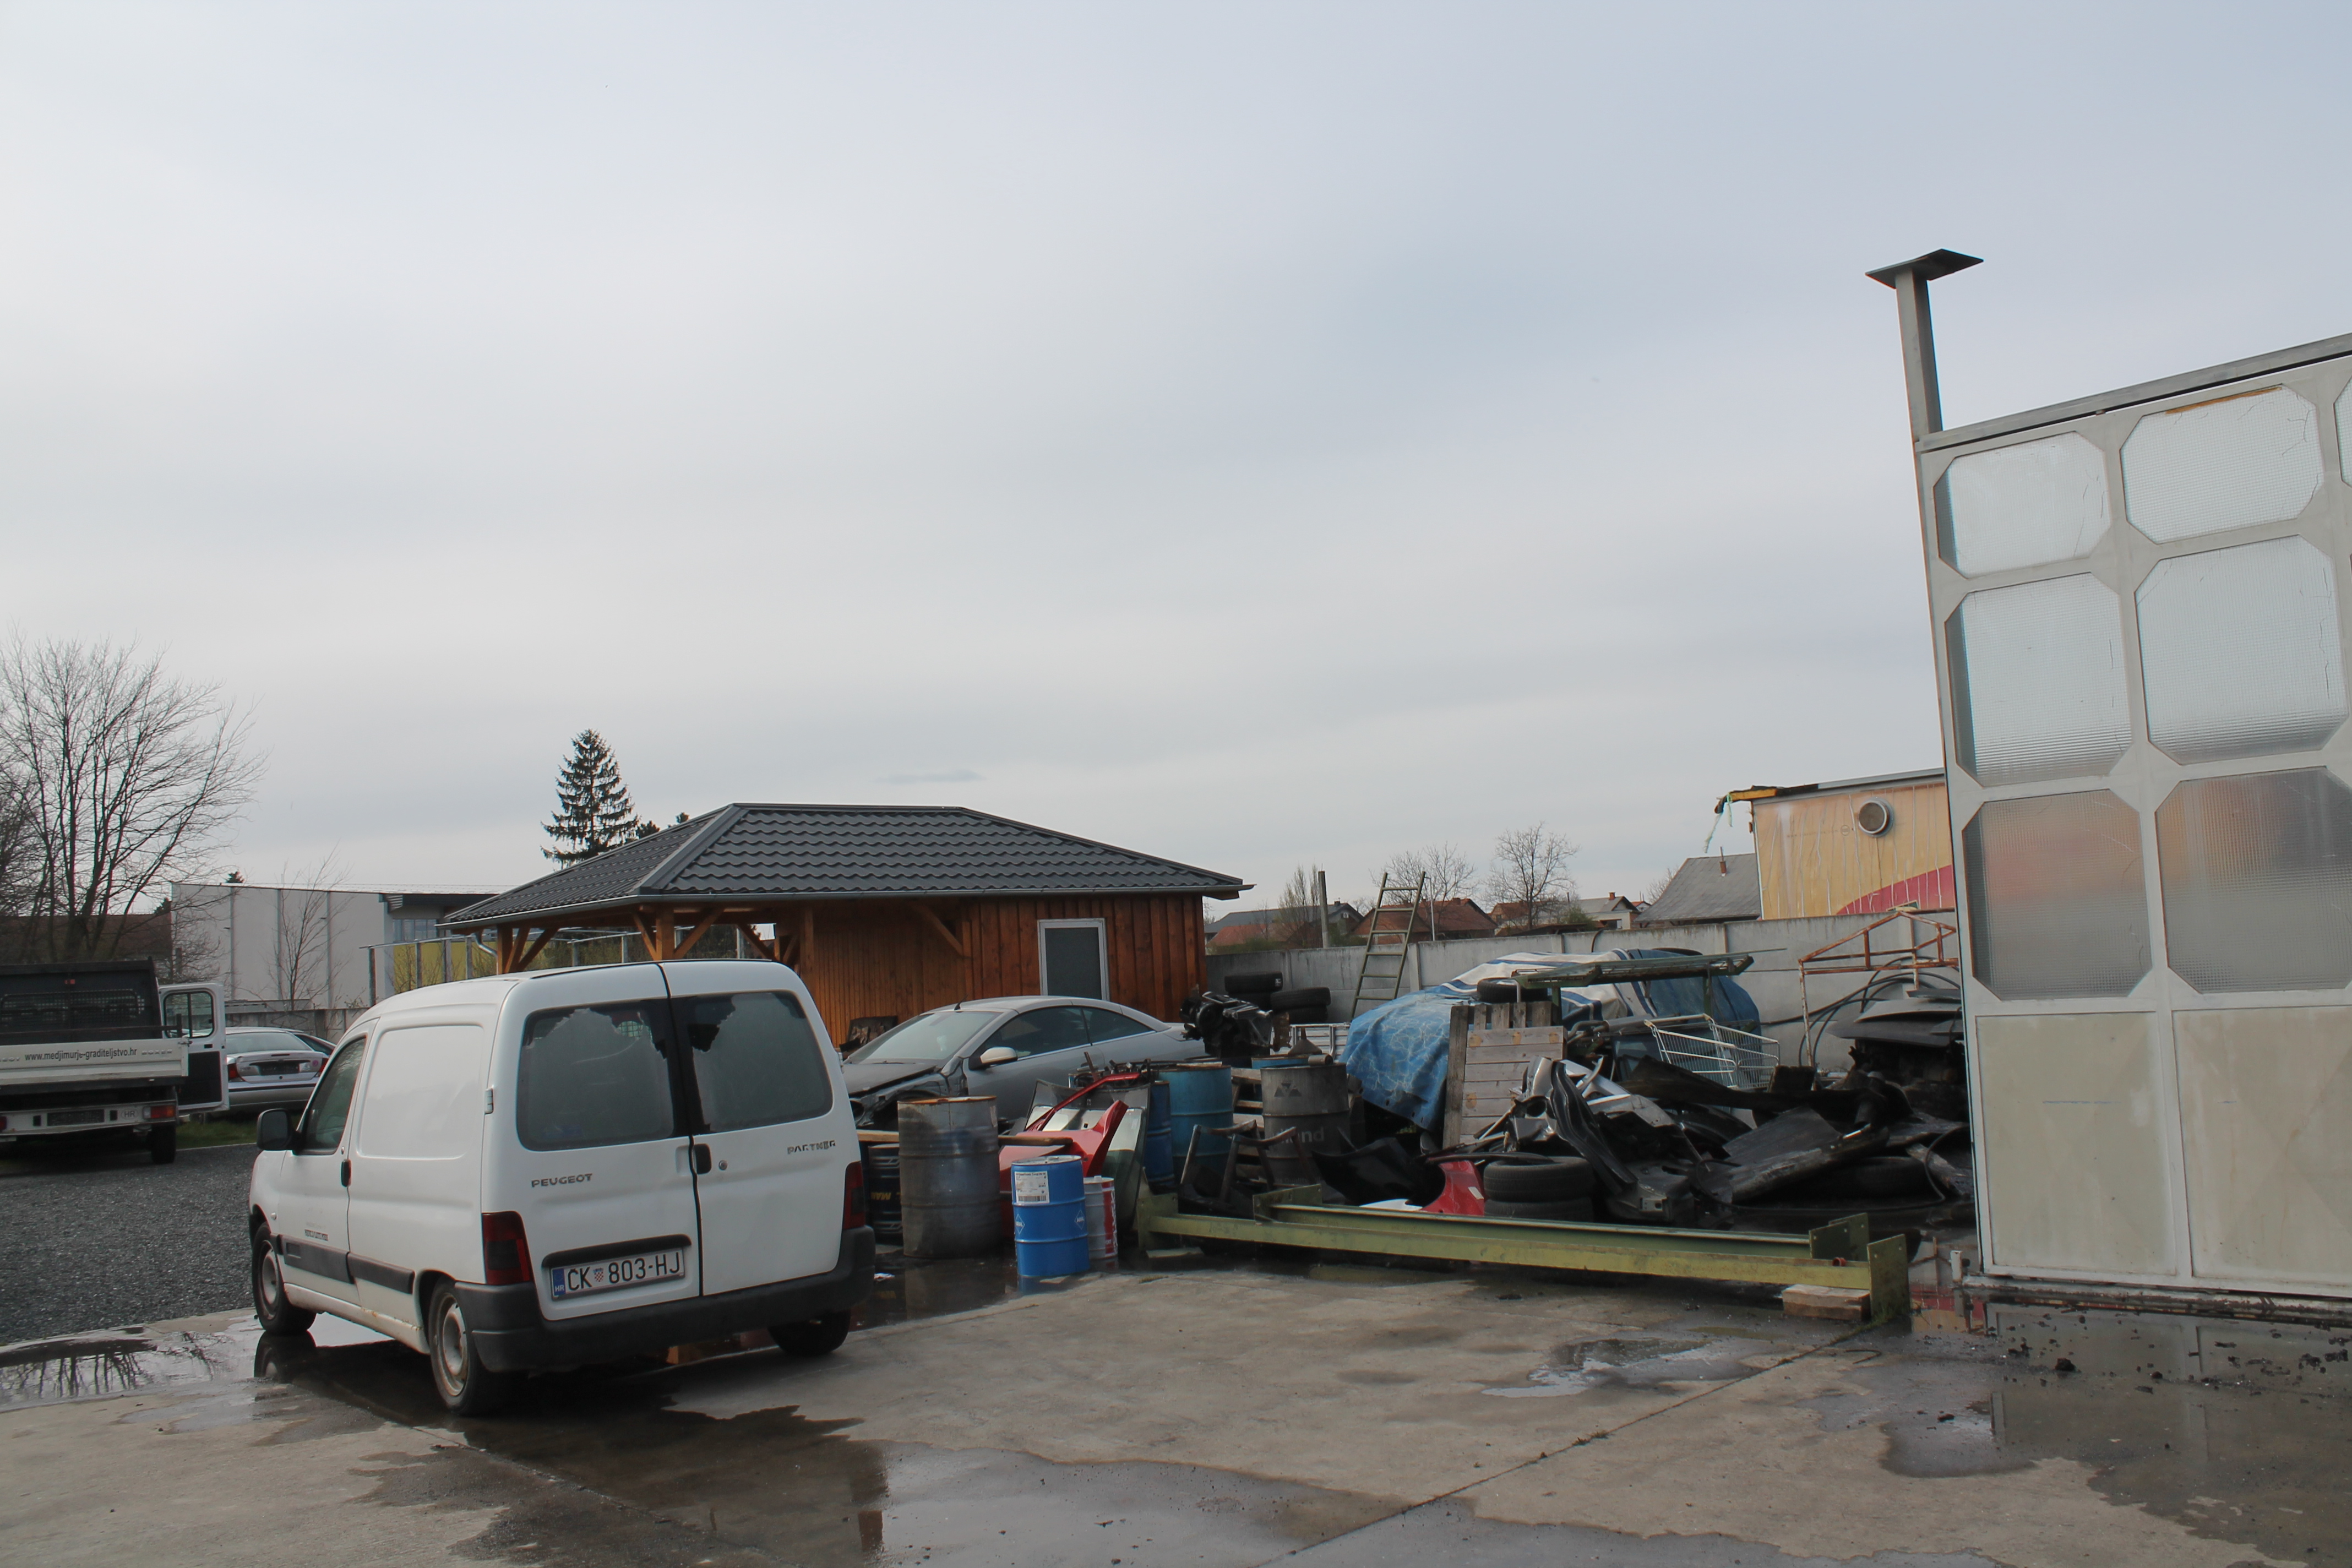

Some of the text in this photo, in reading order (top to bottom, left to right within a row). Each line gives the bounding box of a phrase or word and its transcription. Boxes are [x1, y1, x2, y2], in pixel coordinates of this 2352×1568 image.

[25, 1047, 137, 1061] www.medjimurje-graditeljstvo.hr
[787, 1140, 836, 1155] PARTNER
[531, 1173, 593, 1188] PEUGEOT
[608, 1252, 680, 1283] 803-HJ
